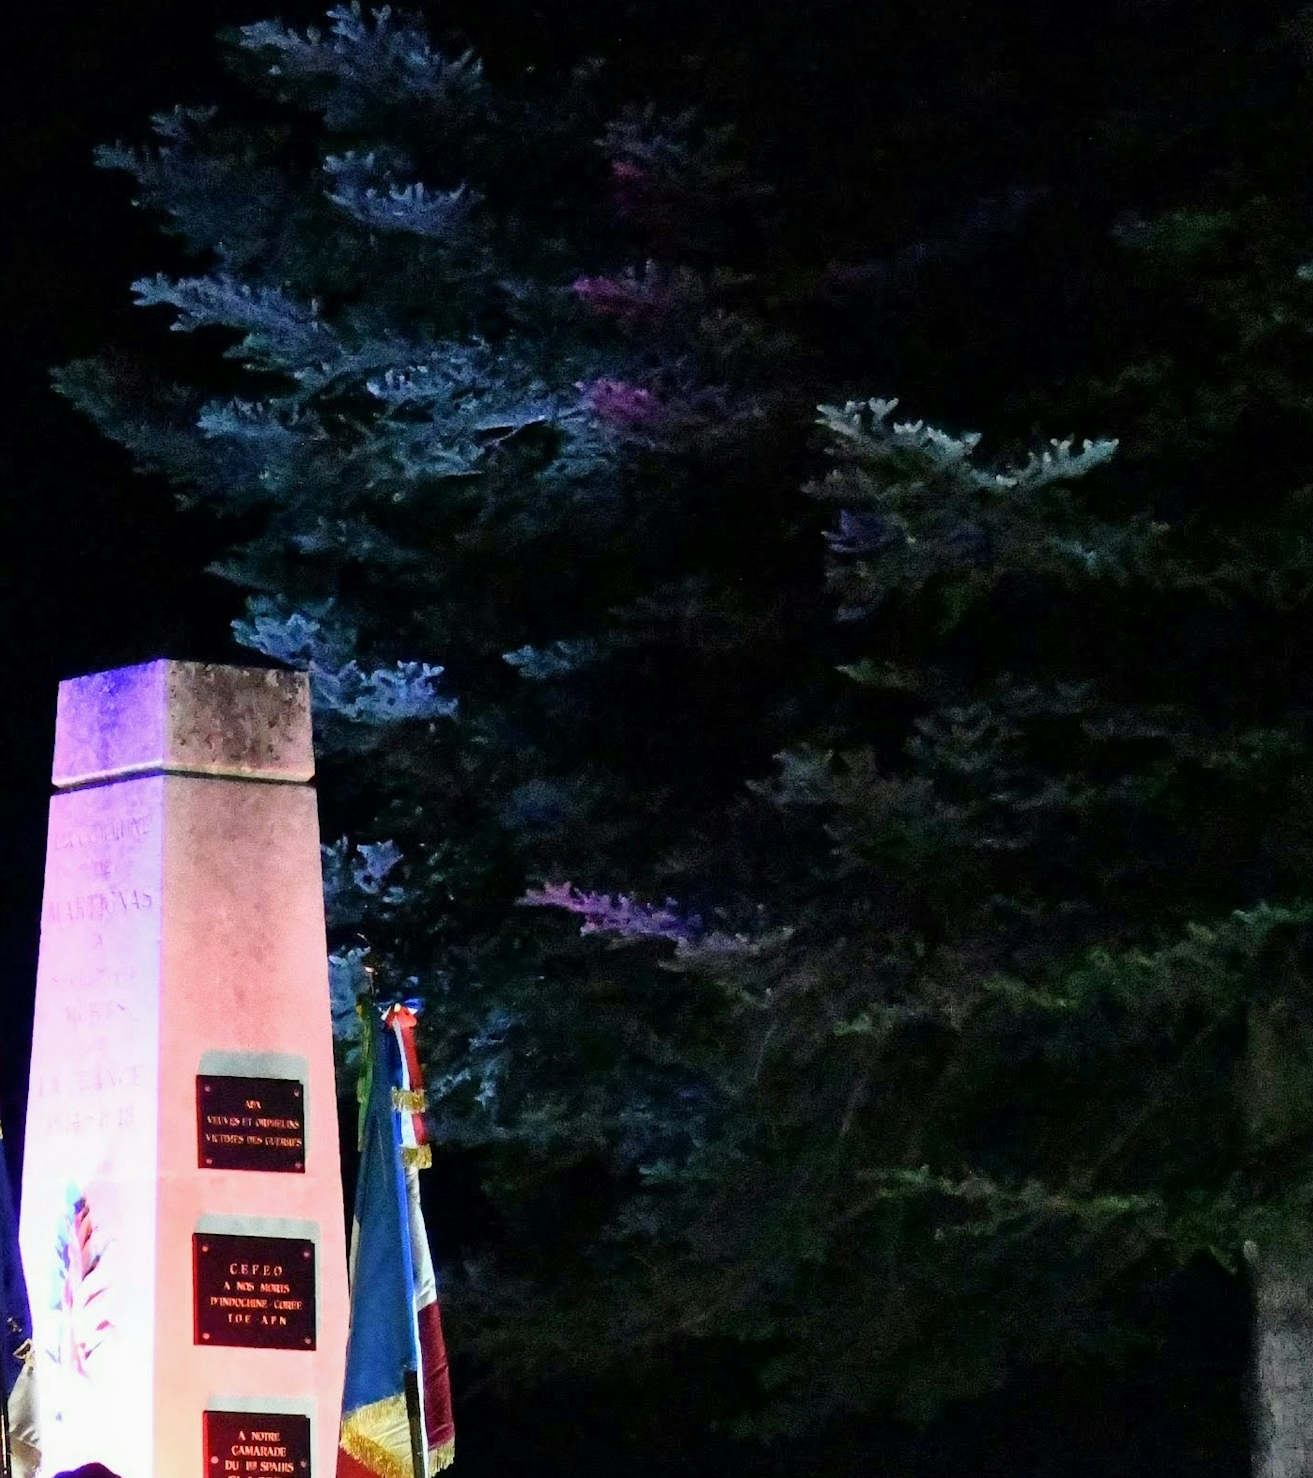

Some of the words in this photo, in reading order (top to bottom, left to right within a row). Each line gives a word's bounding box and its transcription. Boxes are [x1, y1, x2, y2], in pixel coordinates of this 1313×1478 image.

[207, 1115, 240, 1126] VEUVES
[242, 1117, 252, 1126] ET
[255, 1118, 300, 1129] ORPHELINS
[205, 1133, 244, 1144] VICTIMES
[246, 1135, 262, 1144] DES
[264, 1136, 302, 1147] GUERRES
[223, 1281, 230, 1290] A
[236, 1281, 254, 1291] NOS
[260, 1283, 290, 1293] MORTS
[210, 1296, 267, 1308] D'INDOCHINE
[238, 1430, 245, 1440] A
[251, 1431, 280, 1441] NOTRE
[231, 1445, 286, 1456] CAMARADE
[224, 1459, 239, 1470] DU
[260, 1461, 294, 1472] SPAHIS
